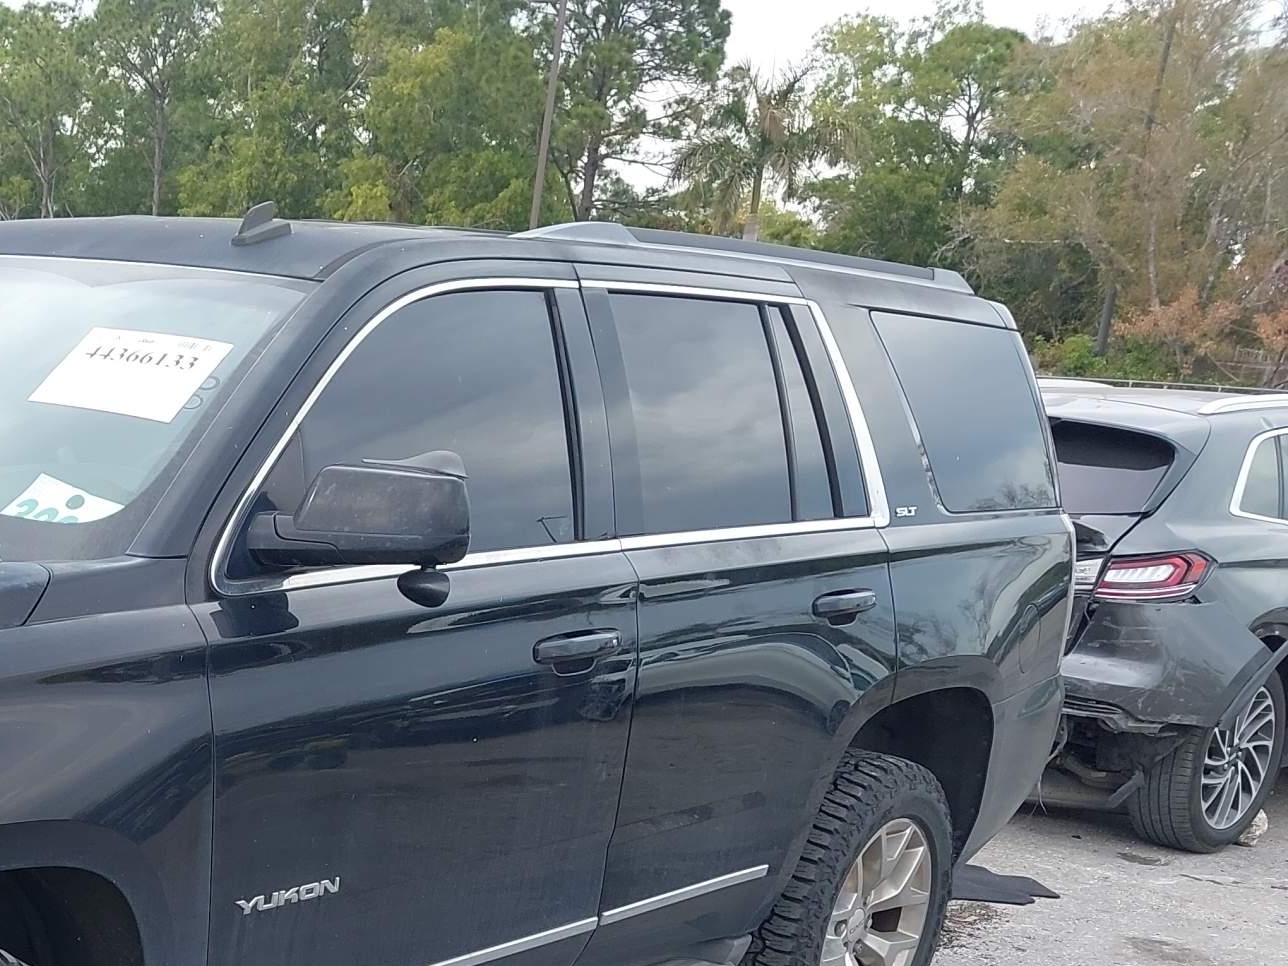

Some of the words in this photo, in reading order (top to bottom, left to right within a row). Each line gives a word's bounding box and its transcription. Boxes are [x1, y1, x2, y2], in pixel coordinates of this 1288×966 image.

[85, 344, 200, 371] 44366133
[895, 506, 918, 517] SLT
[234, 876, 340, 915] YUKON
